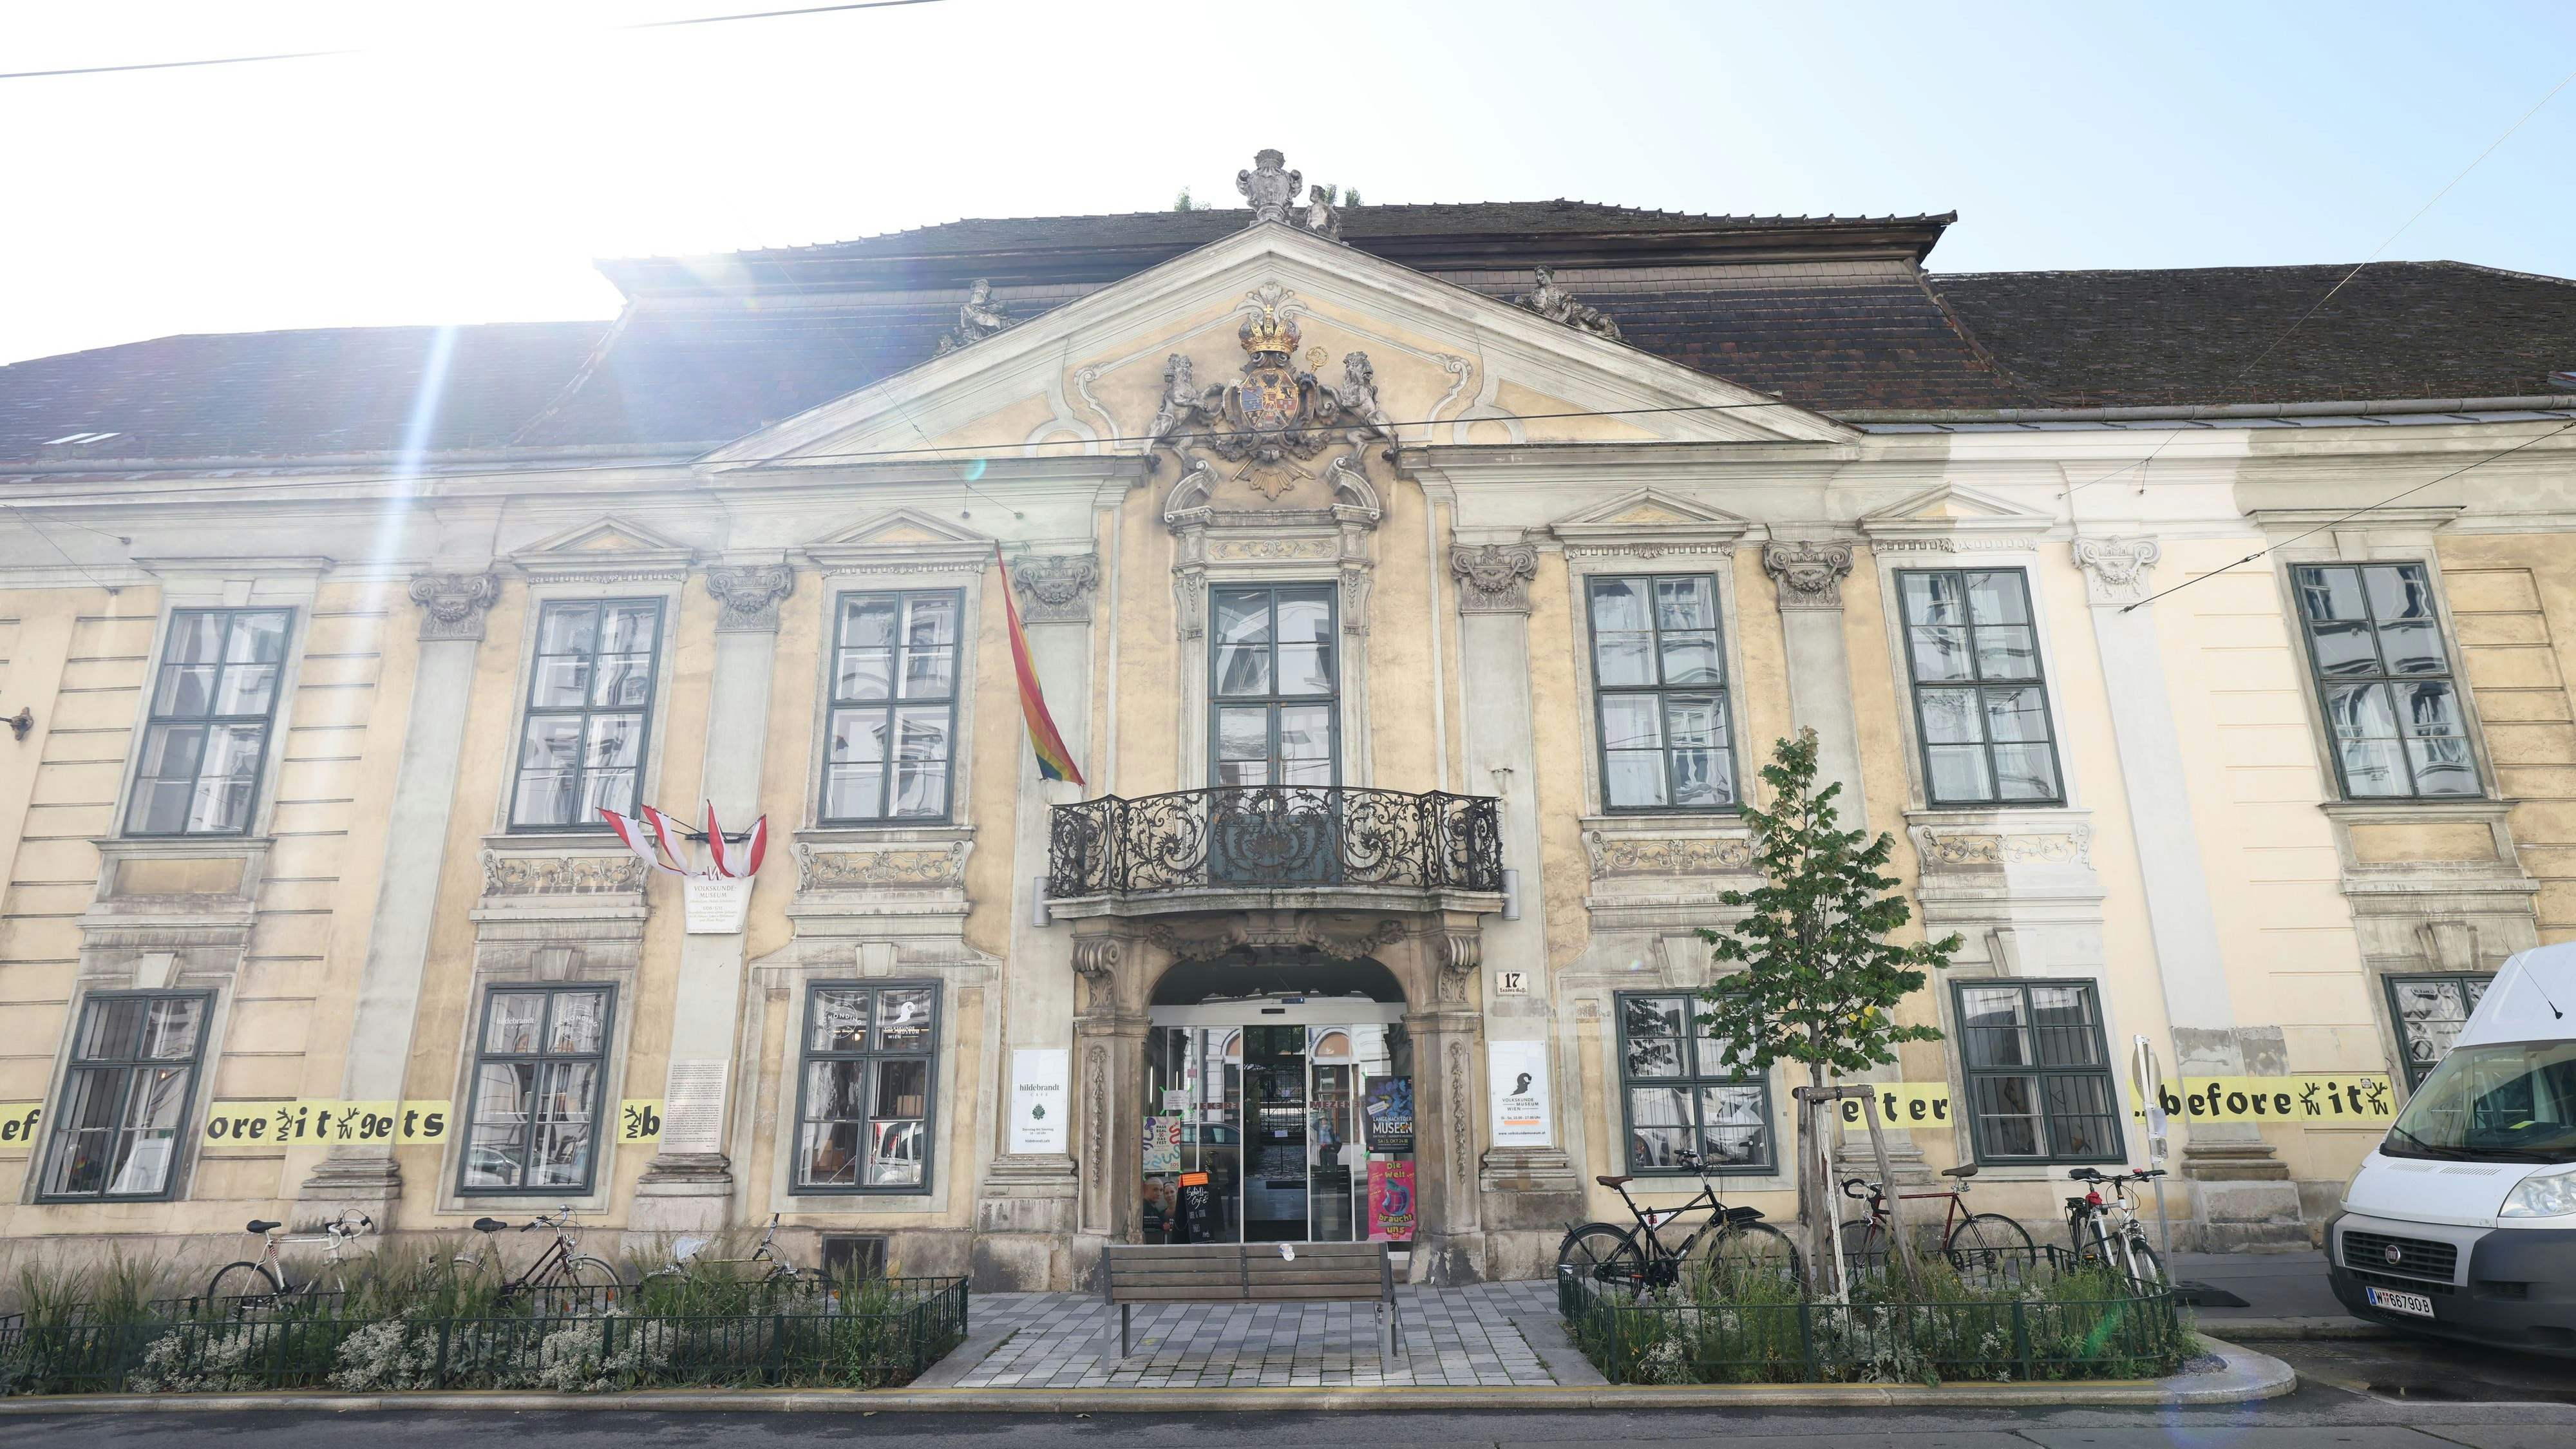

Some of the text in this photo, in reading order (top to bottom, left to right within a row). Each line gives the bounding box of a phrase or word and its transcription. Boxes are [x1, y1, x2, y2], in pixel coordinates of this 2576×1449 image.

[1505, 973, 1520, 988] 17
[2328, 1082, 2363, 1115] it
[1842, 1092, 1948, 1122] eter
[1, 1109, 41, 1142] ef
[359, 1110, 444, 1139] gets
[1373, 1122, 1412, 1133] MUSEEN
[1378, 1213, 1413, 1222] braucht
[2388, 1250, 2396, 1260] FIAT
[2374, 1291, 2383, 1304] W
